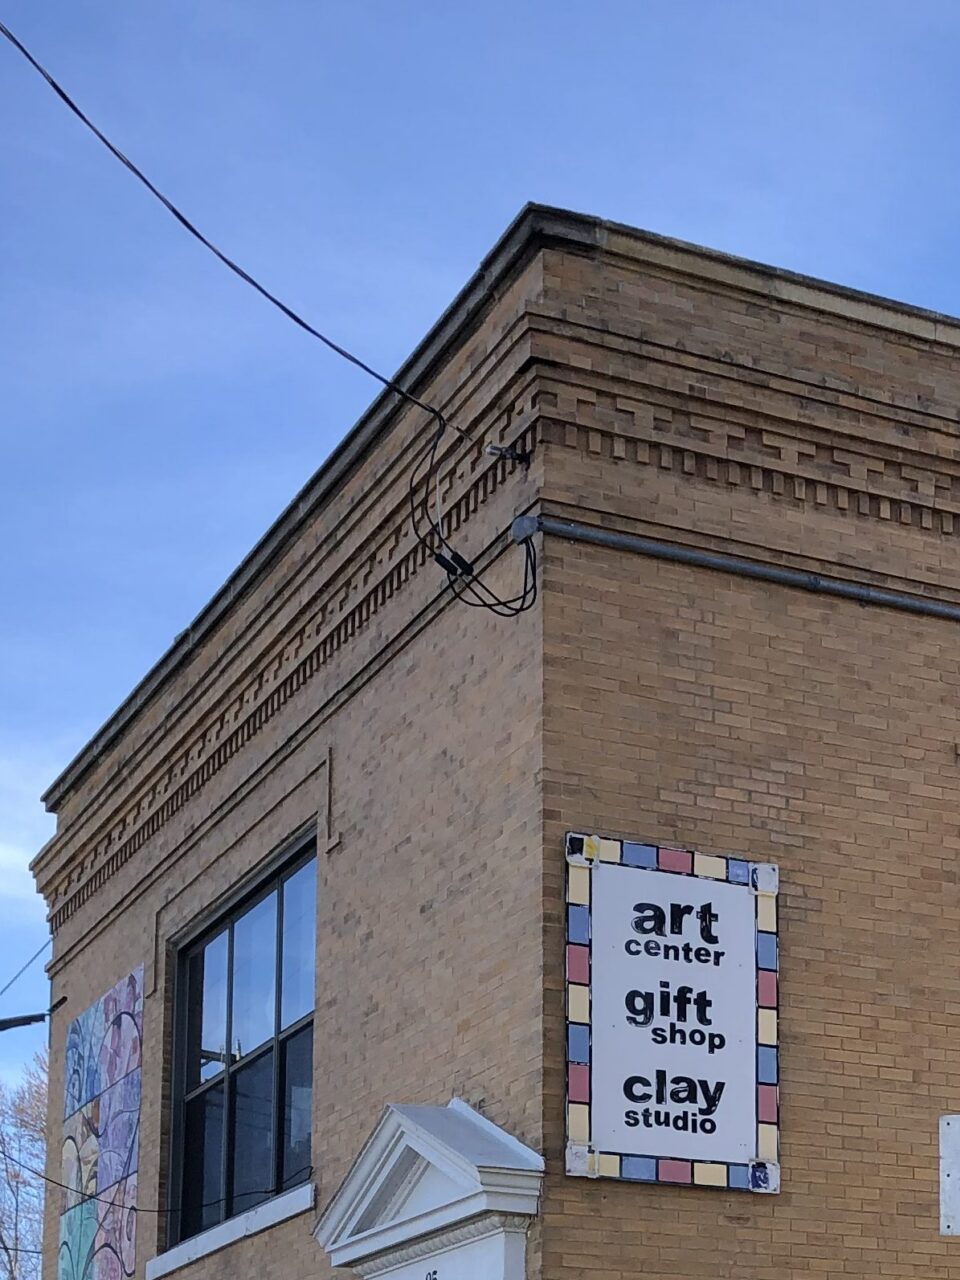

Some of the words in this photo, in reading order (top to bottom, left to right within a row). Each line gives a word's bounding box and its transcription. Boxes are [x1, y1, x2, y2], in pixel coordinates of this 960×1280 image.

[631, 901, 720, 945] art
[624, 938, 726, 967] center
[624, 980, 713, 1028] gift
[651, 1022, 726, 1055] shop
[622, 1069, 726, 1117] clay
[624, 1107, 718, 1135] studio
